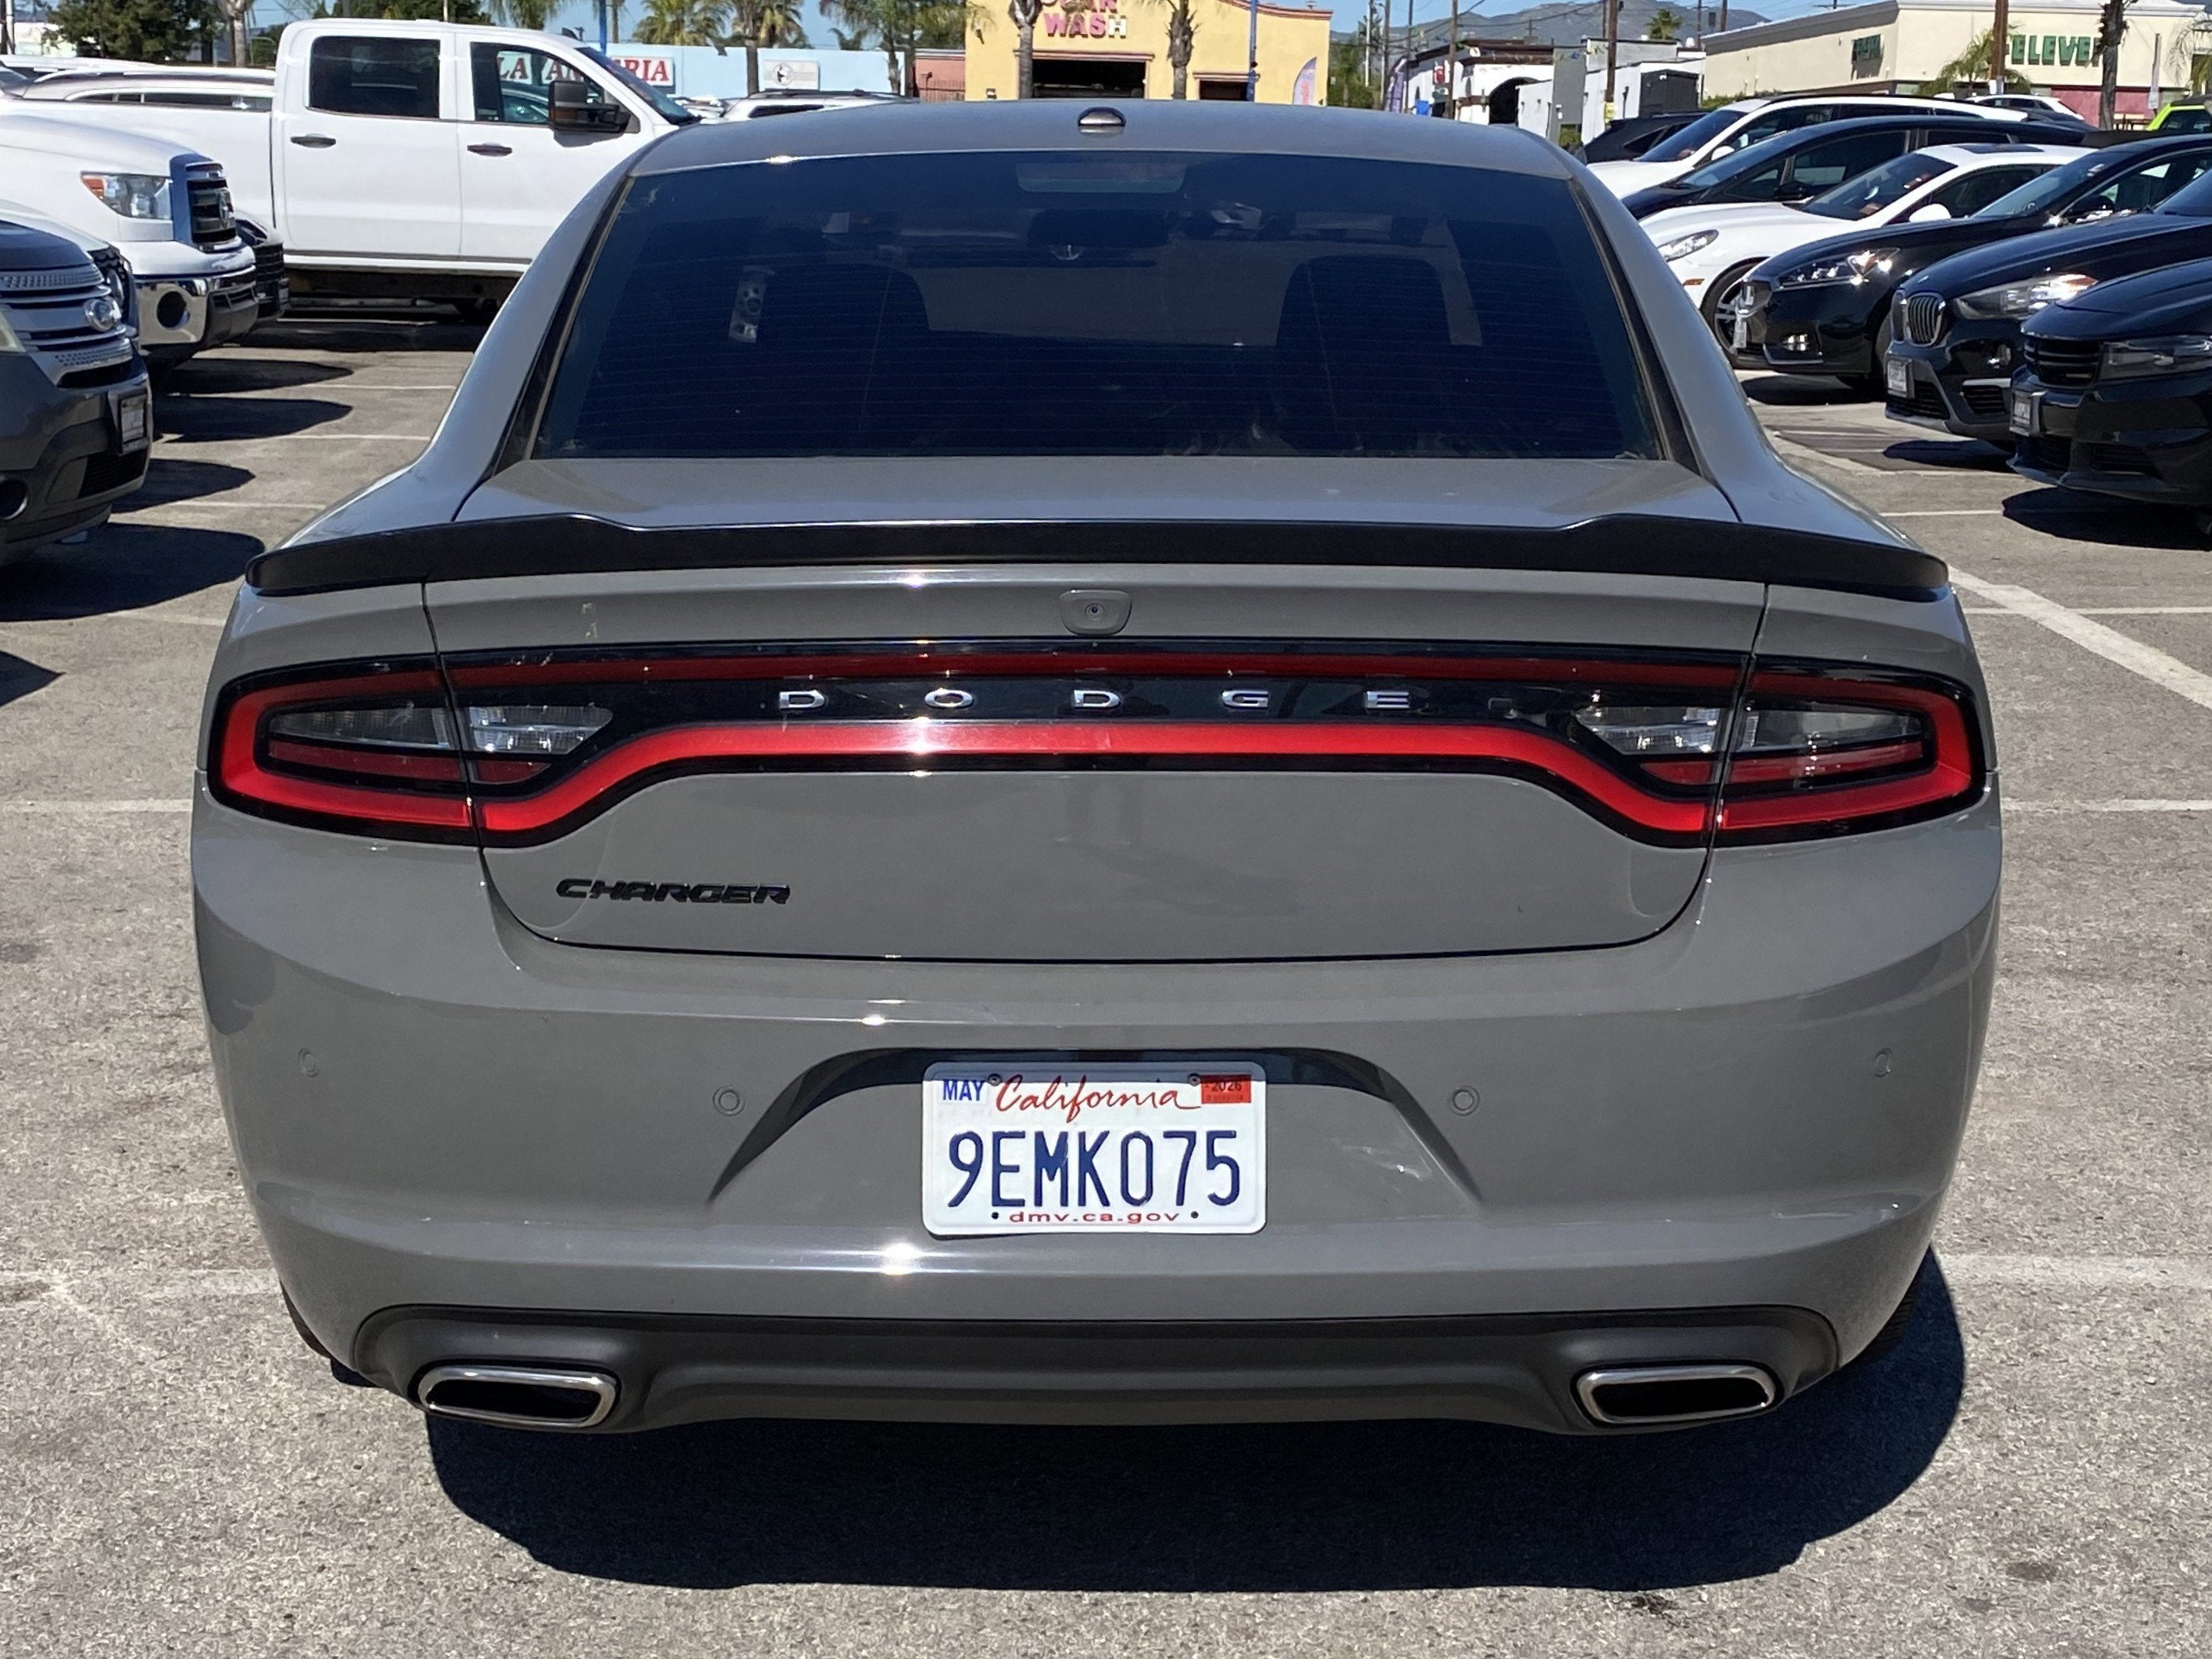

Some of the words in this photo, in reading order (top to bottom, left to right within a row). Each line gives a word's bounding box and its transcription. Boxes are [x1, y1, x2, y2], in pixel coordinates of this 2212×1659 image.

[1043, 13, 1127, 39] WASH
[779, 688, 1409, 709] DODGE
[556, 878, 790, 904] CHARGER
[942, 1080, 983, 1102] MAY
[996, 1074, 1201, 1123] California
[949, 1130, 1240, 1207] 9EMK075
[1009, 1211, 1179, 1224] dmv.ca.gov
